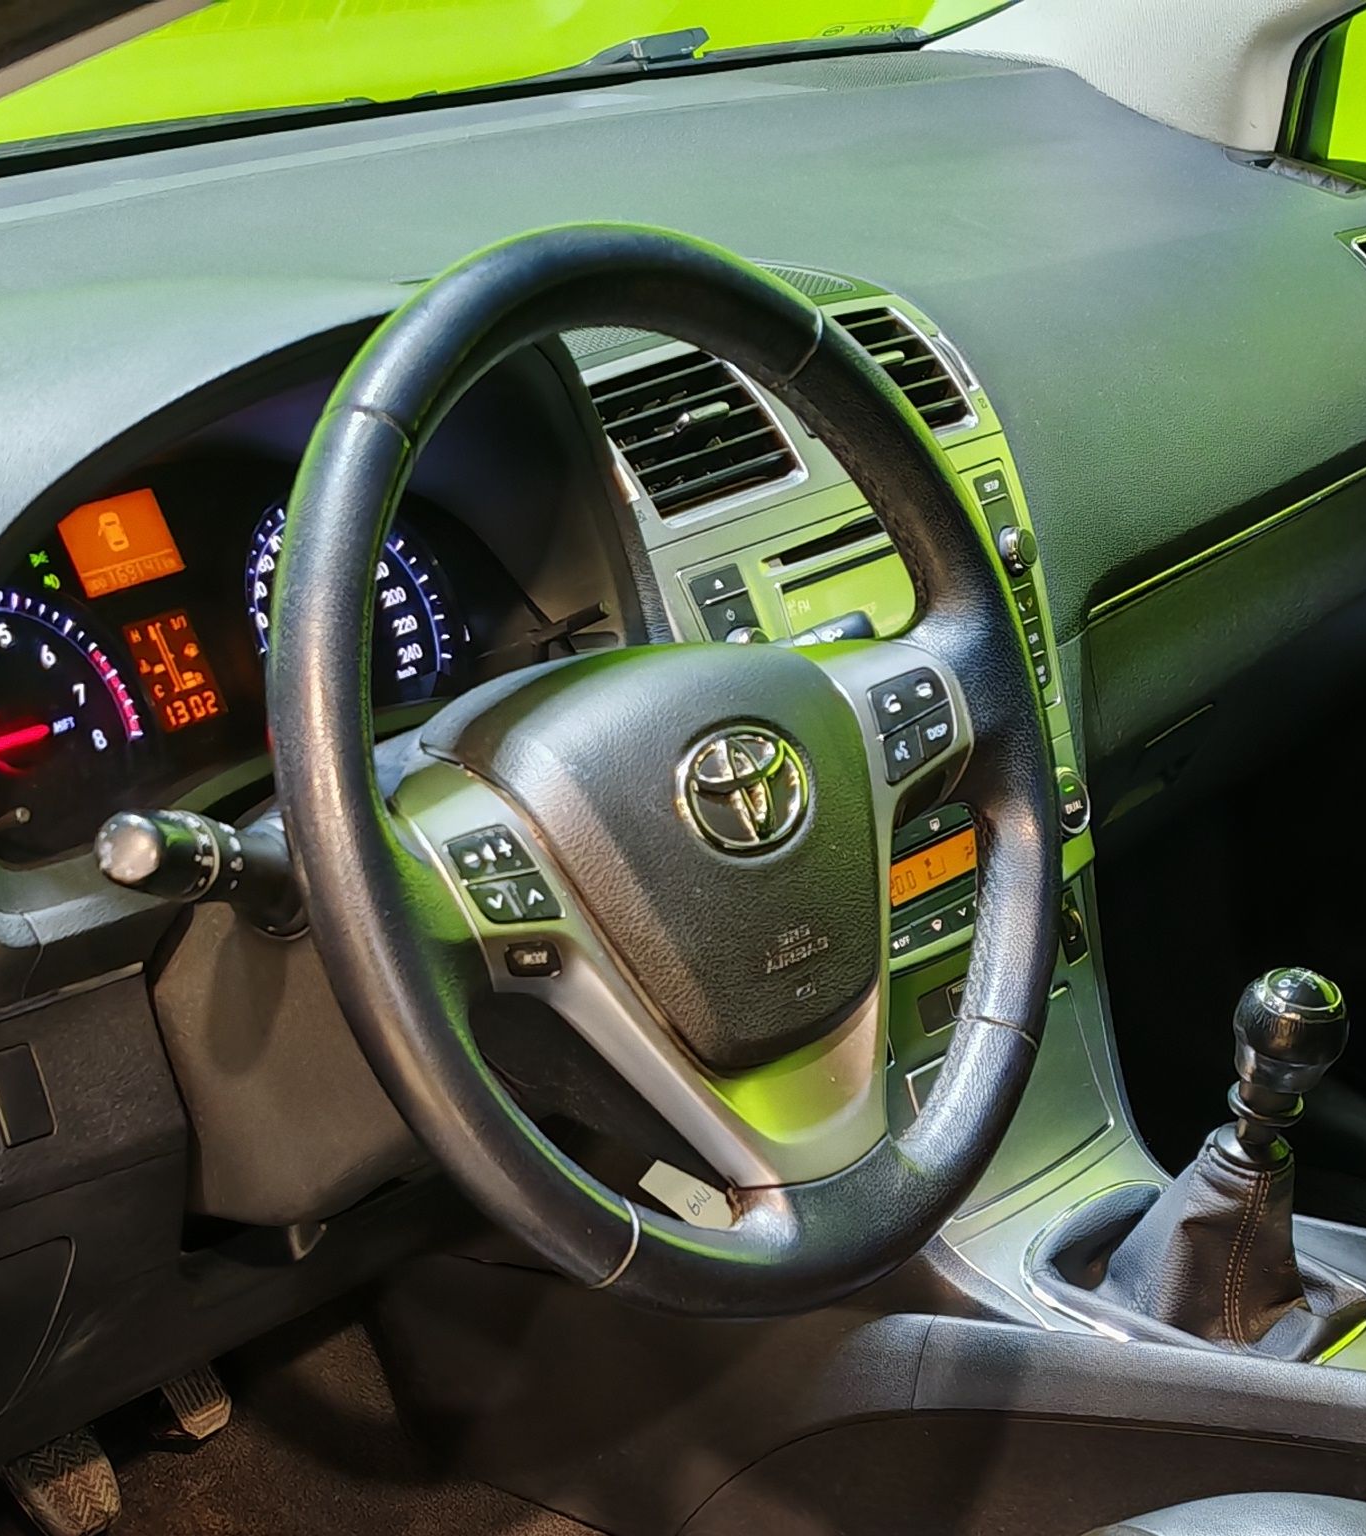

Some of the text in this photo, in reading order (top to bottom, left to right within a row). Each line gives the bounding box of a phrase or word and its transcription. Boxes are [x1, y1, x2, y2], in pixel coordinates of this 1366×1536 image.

[381, 586, 407, 609] 200
[392, 615, 418, 637] 220
[40, 644, 56, 669] 6
[397, 643, 423, 665] 240
[72, 683, 85, 707] 7
[92, 729, 108, 750] 8
[1065, 799, 1084, 815] DUAL
